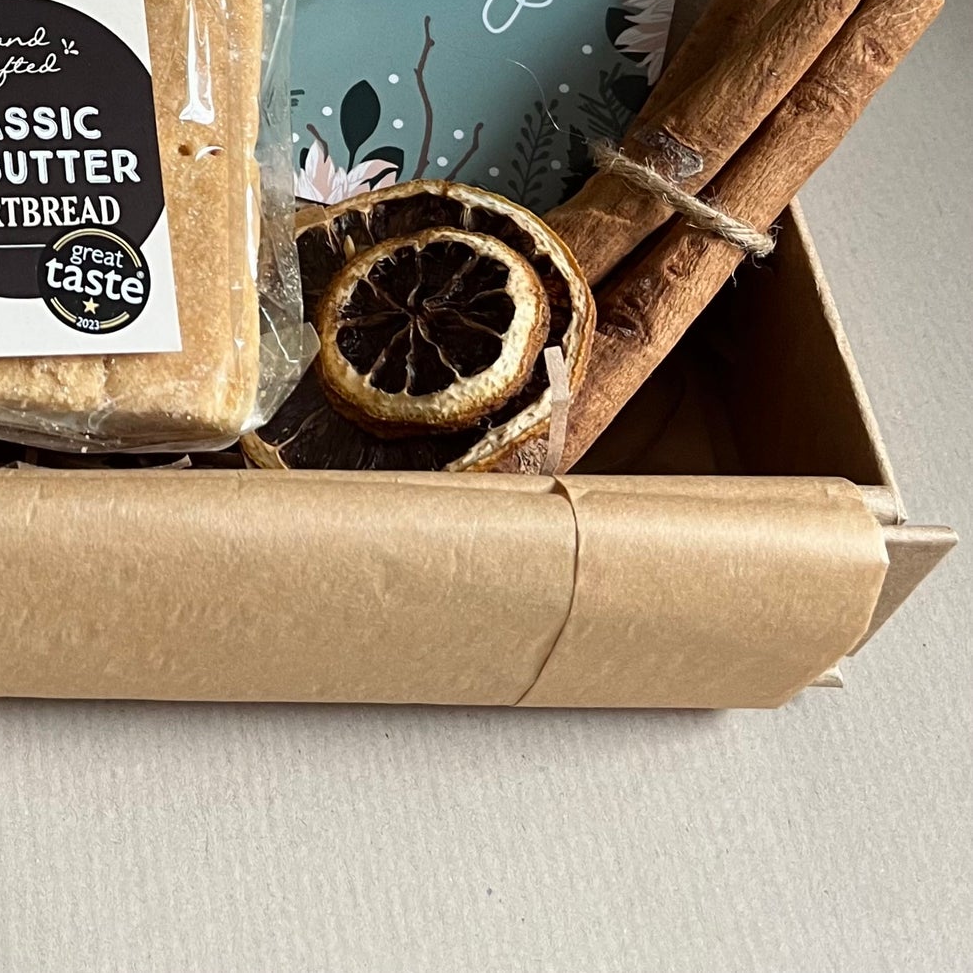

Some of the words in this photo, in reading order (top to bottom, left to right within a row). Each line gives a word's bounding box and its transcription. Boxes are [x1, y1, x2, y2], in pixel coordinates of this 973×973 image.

[70, 244, 124, 269] great
[45, 258, 144, 304] taste
[76, 317, 100, 331] 2023
